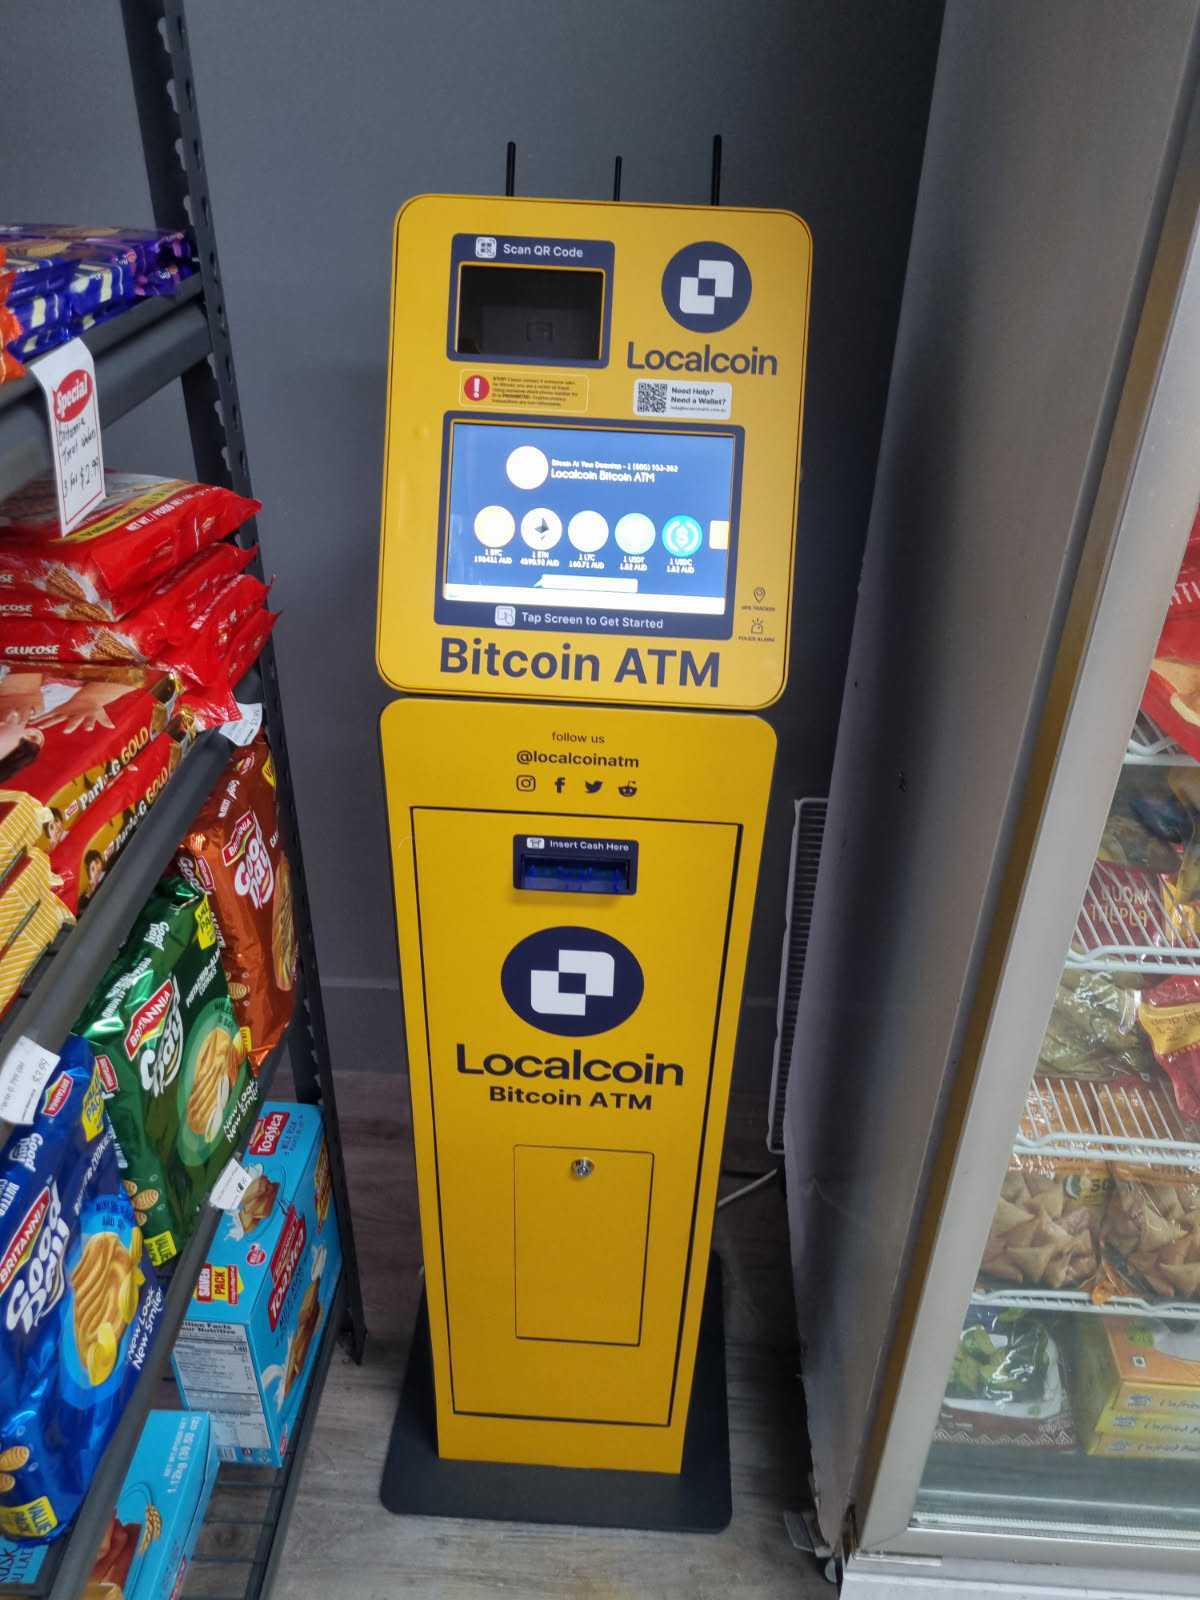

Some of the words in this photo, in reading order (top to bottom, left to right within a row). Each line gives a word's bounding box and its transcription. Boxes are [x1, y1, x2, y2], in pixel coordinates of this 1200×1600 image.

[503, 243, 531, 255] Scan
[534, 245, 551, 256] QR
[553, 246, 584, 258] Code
[627, 341, 778, 376] Localcoin
[56, 372, 89, 419] Special
[670, 396, 691, 405] Need
[698, 398, 727, 406] Wallet?
[671, 387, 692, 395] Need
[692, 388, 714, 397] Help?
[551, 468, 597, 480] Localcoin
[599, 470, 632, 482] Bitcoin
[634, 472, 655, 483] ATM
[522, 611, 542, 624] Tap
[545, 613, 583, 626] Screen
[586, 615, 596, 626] to
[599, 616, 619, 627] Get
[622, 617, 664, 629] Started
[5, 644, 60, 655] GLUCOSE
[439, 637, 601, 682] Bitcoin
[614, 648, 721, 688] ATM
[121, 726, 149, 764] GOLD
[552, 731, 587, 743] follow
[591, 735, 605, 744] us
[516, 750, 640, 768] @localcoinatm
[145, 766, 169, 805] GOLD
[550, 840, 577, 849] Insert
[580, 841, 604, 850] Cash
[606, 842, 629, 851] Here
[155, 921, 171, 951] Good
[130, 990, 171, 1047] BRITANNIA
[456, 1043, 684, 1086] Localcoin
[223, 1106, 239, 1132] New
[238, 1079, 255, 1111] Look
[489, 1086, 582, 1107] Bitcoin
[590, 1092, 653, 1111] ATM
[225, 1116, 241, 1144] New
[257, 1113, 284, 1153] Toastea
[24, 1132, 44, 1173] Good
[0, 1202, 46, 1283] BRITANNIA
[5, 1179, 62, 1332] Good
[214, 1271, 226, 1295] PACK
[127, 1327, 143, 1362] New
[139, 1286, 155, 1326] Look
[131, 1332, 149, 1371] New
[0, 1548, 14, 1584] USK
